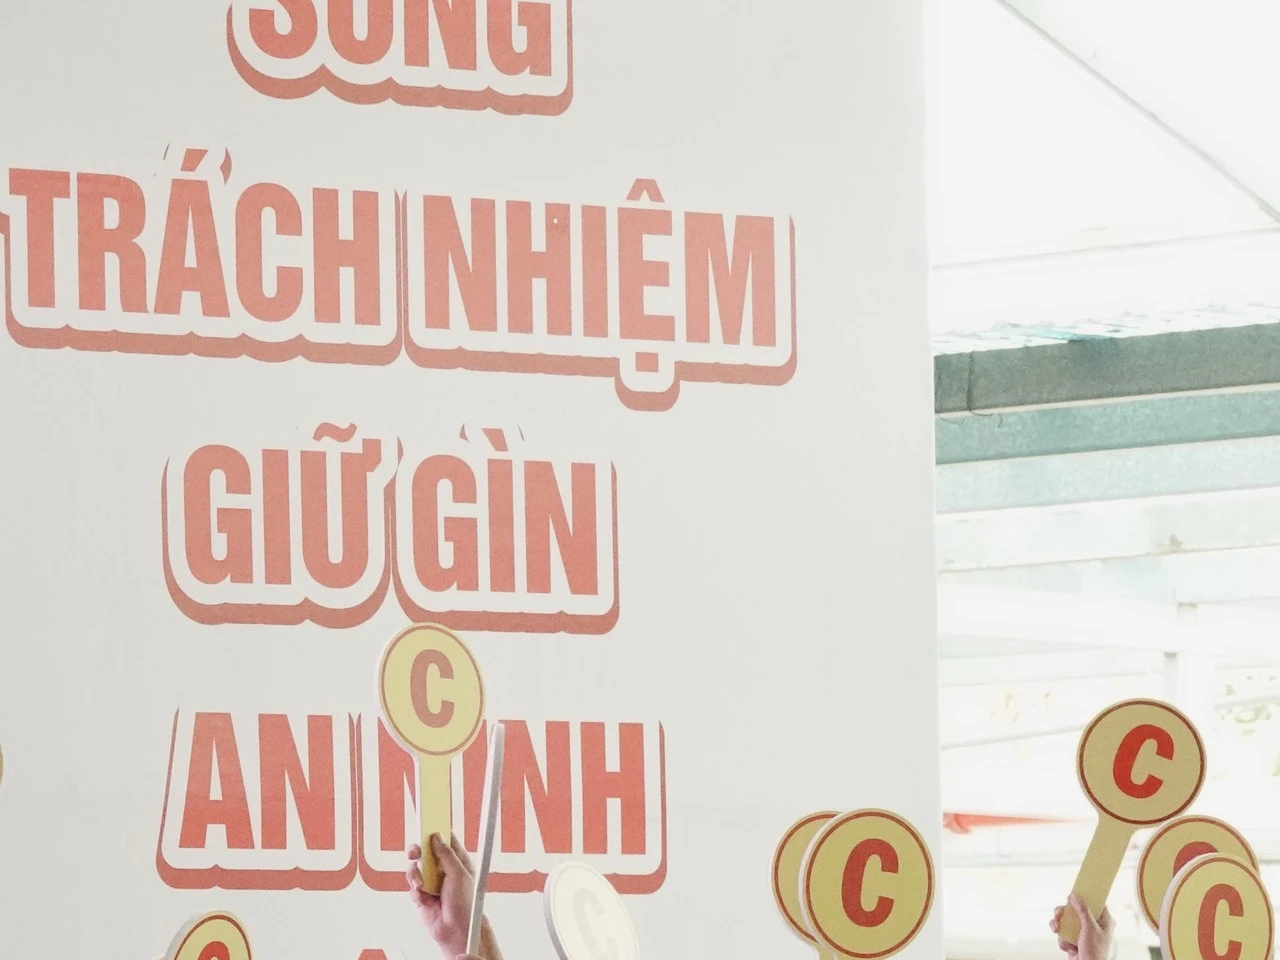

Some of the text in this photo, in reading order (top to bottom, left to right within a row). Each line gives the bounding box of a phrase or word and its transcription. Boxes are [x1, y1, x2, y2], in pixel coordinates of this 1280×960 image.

[8, 148, 777, 373] TRÁCH NHIỆM
[183, 422, 599, 596] GIỮ GÌN
[410, 648, 455, 728] C
[178, 711, 647, 856] AN NINH
[1112, 724, 1175, 799] C
[841, 838, 899, 928] C
